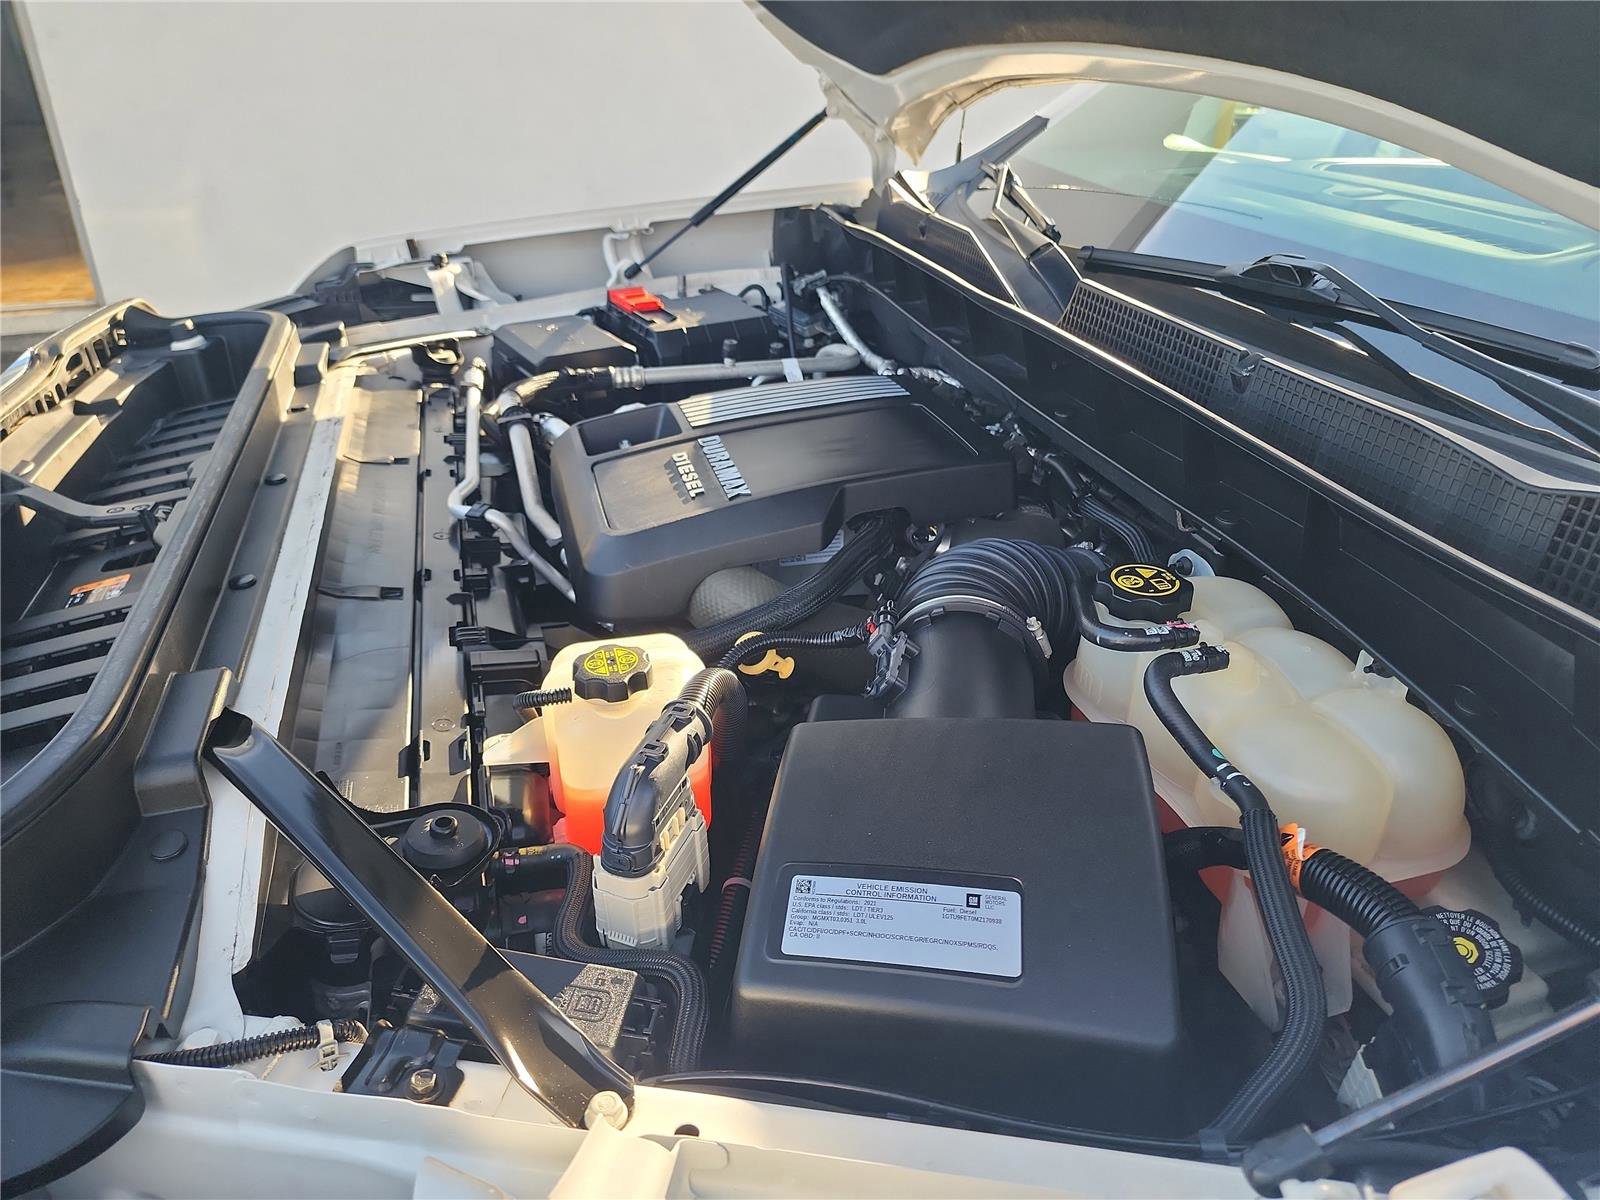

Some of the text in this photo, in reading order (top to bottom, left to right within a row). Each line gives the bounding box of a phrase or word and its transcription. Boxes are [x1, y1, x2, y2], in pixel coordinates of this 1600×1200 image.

[697, 434, 752, 501] DURAMAX
[671, 451, 705, 500] DIESEL
[845, 888, 937, 902] CONTROL INFORMATION
[857, 883, 928, 895] VEHICLE EMISSION
[790, 913, 809, 921] Group:
[791, 907, 817, 915] California
[959, 907, 977, 915] Diesel
[1435, 912, 1465, 920] NETTOYER
[1475, 919, 1501, 939] BOUCHON
[1472, 924, 1493, 941] LIQUIDE
